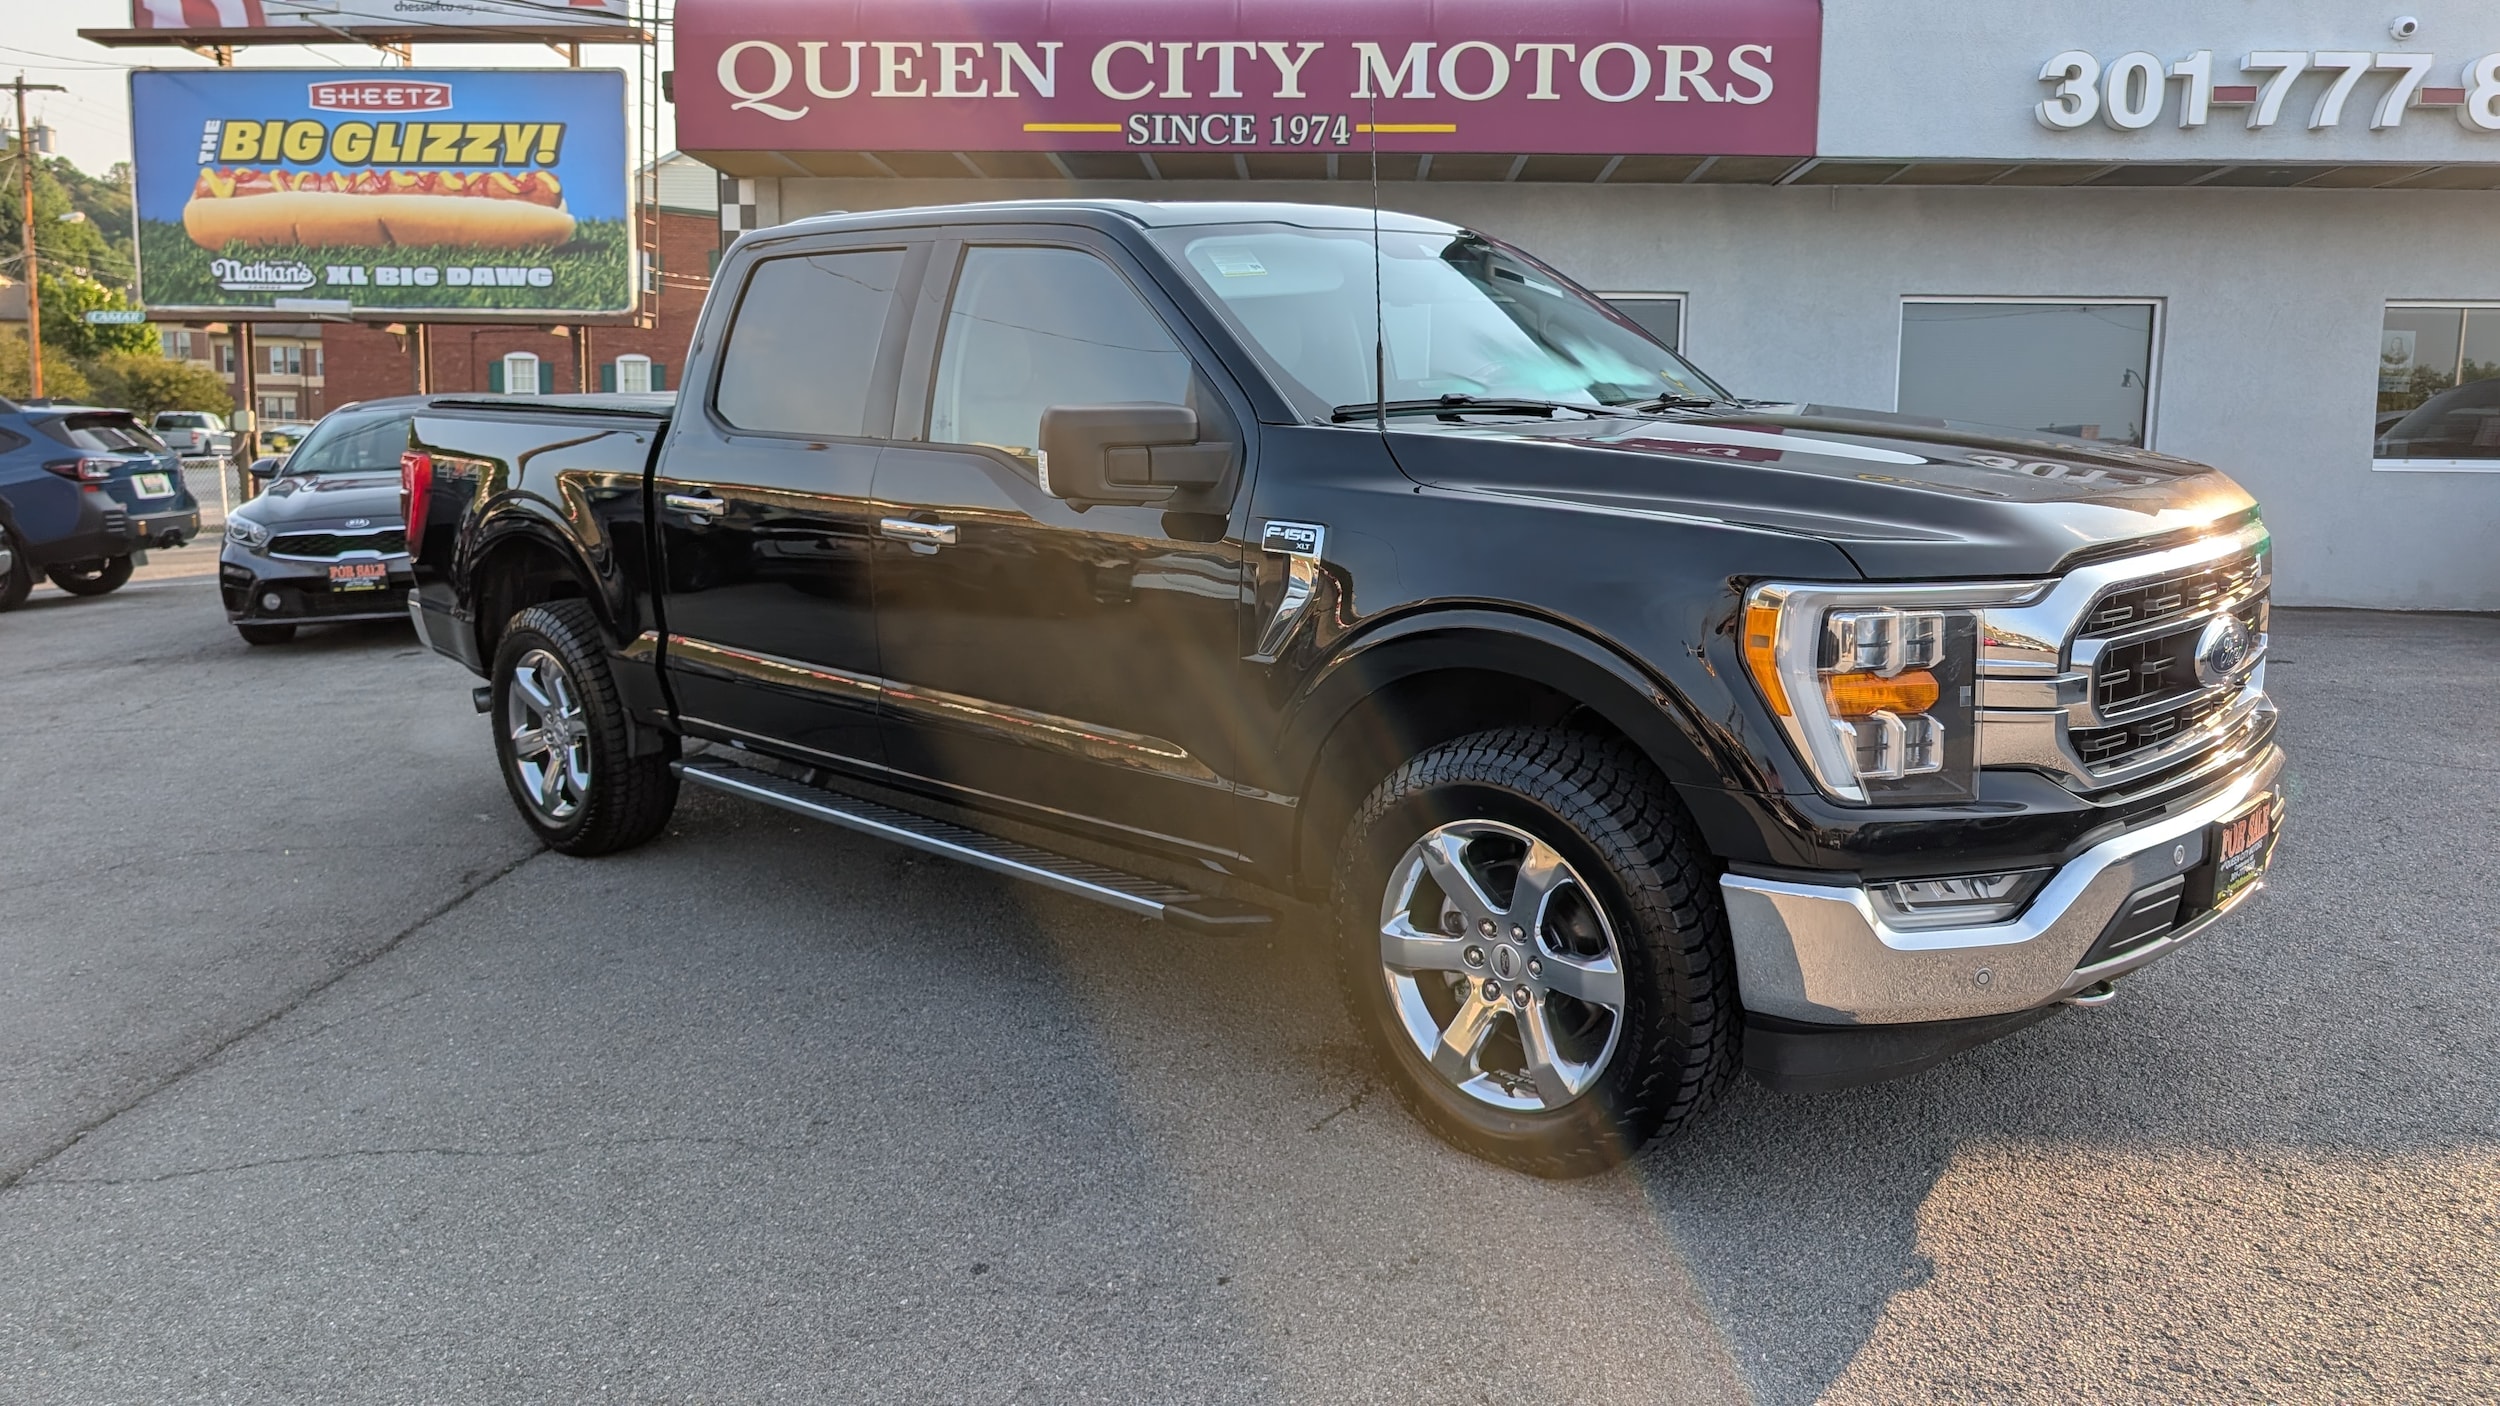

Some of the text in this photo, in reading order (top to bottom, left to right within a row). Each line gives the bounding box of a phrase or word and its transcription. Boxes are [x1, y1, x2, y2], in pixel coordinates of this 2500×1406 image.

[717, 40, 1774, 121] QUEEN CITY MOTORS
[319, 88, 442, 105] SHEETZ
[198, 119, 564, 166] THE BIG GLIZZY!
[1127, 113, 1351, 146] SINCE 1974
[211, 258, 314, 284] Nathan's
[326, 266, 554, 287] XL BIG DAWG
[1266, 526, 1315, 542] F-150
[329, 563, 386, 579] FOR SALE
[2220, 802, 2271, 863] FOR SALE
